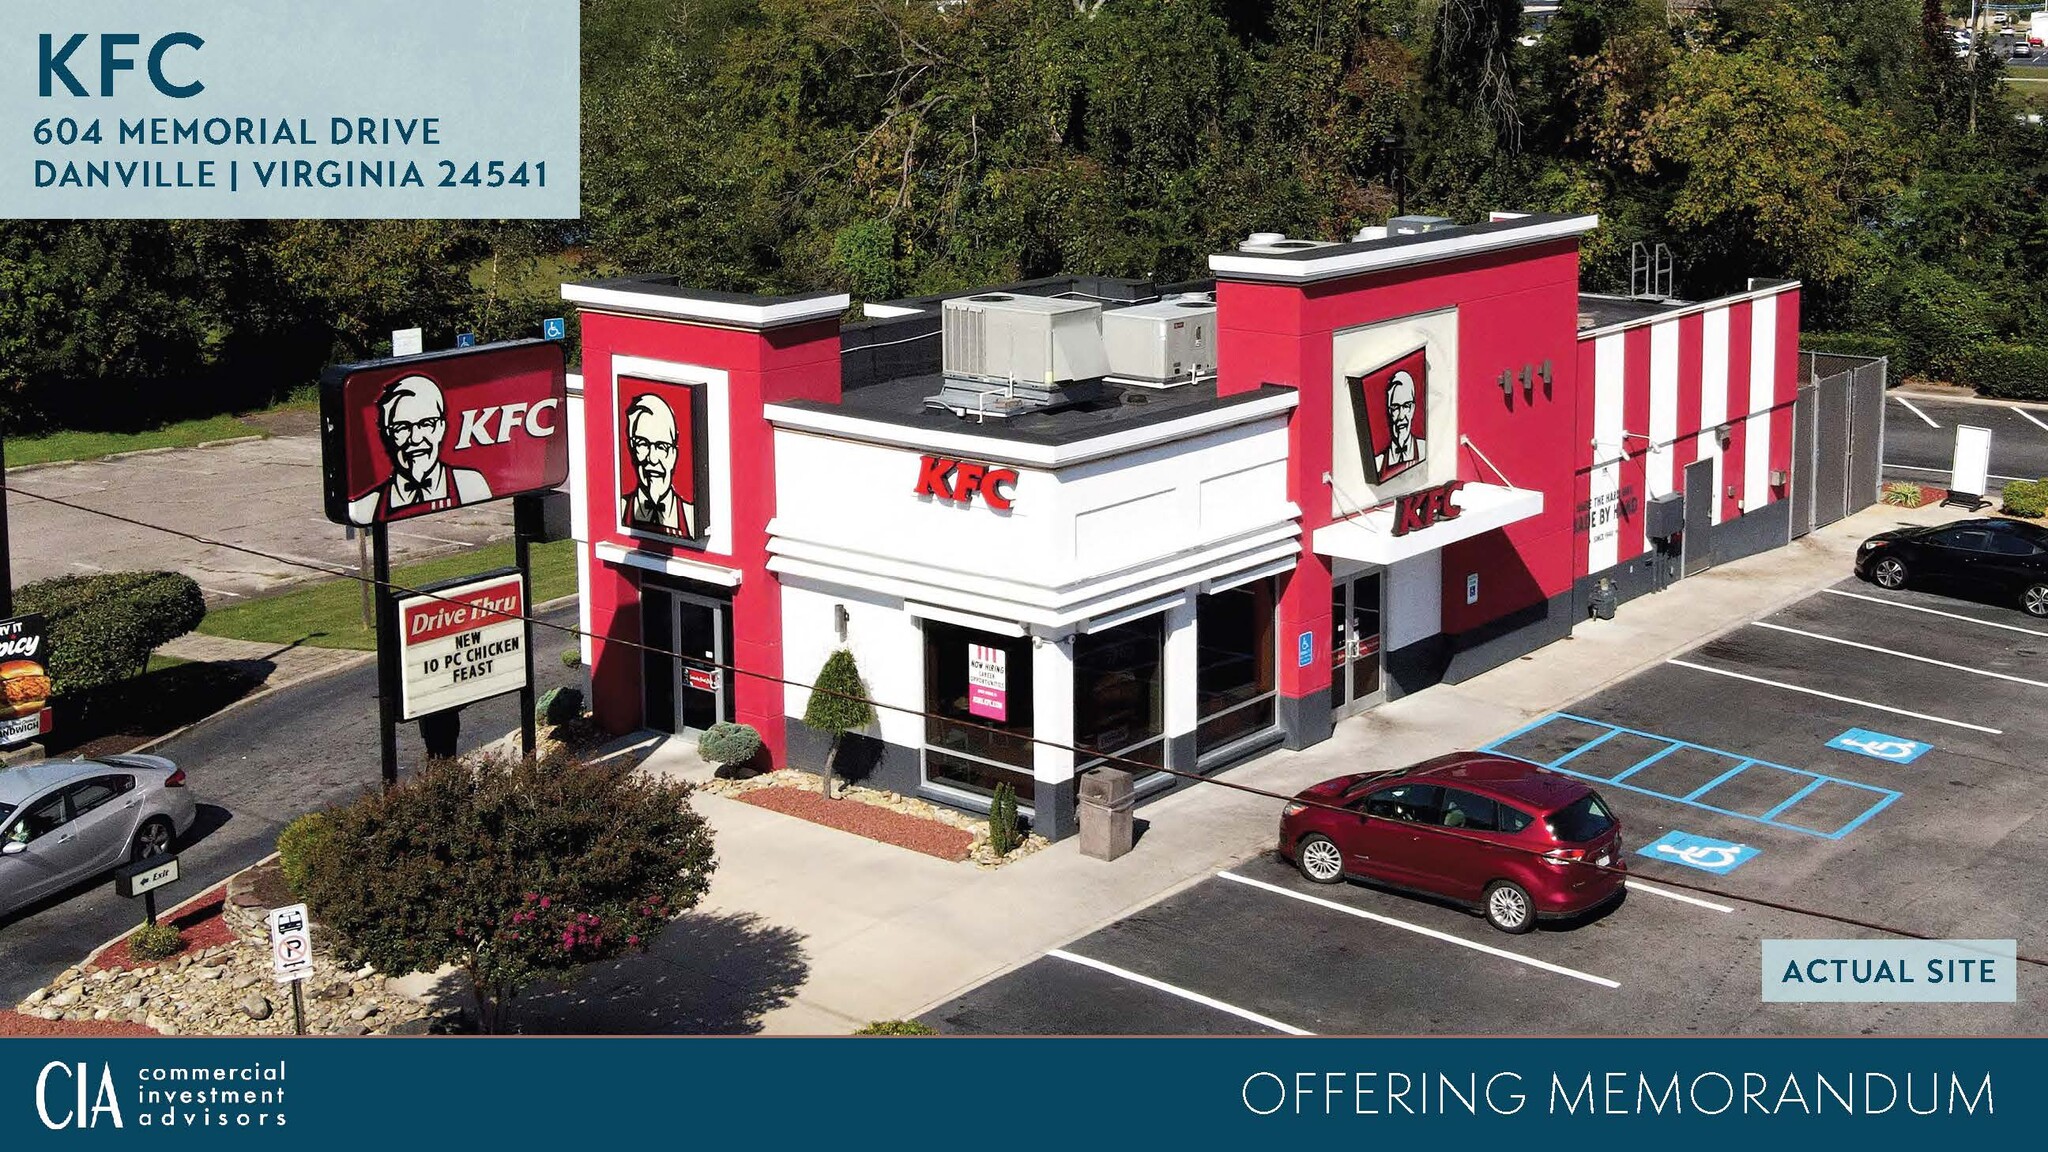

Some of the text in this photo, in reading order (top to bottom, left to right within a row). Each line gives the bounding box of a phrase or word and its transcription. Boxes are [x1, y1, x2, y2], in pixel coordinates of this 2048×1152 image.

[454, 398, 558, 450] KFC
[914, 455, 1019, 513] KFC
[1391, 480, 1464, 537] KFC
[1600, 506, 1611, 525] BY
[411, 595, 517, 636] Drive Thru
[13, 622, 23, 633] IT
[455, 631, 481, 650] NEW
[445, 652, 462, 669] PC
[466, 636, 519, 662] CHICKEN
[453, 660, 493, 683] FEAST
[971, 660, 1004, 674] NOW HIRING
[152, 868, 170, 882] Exit
